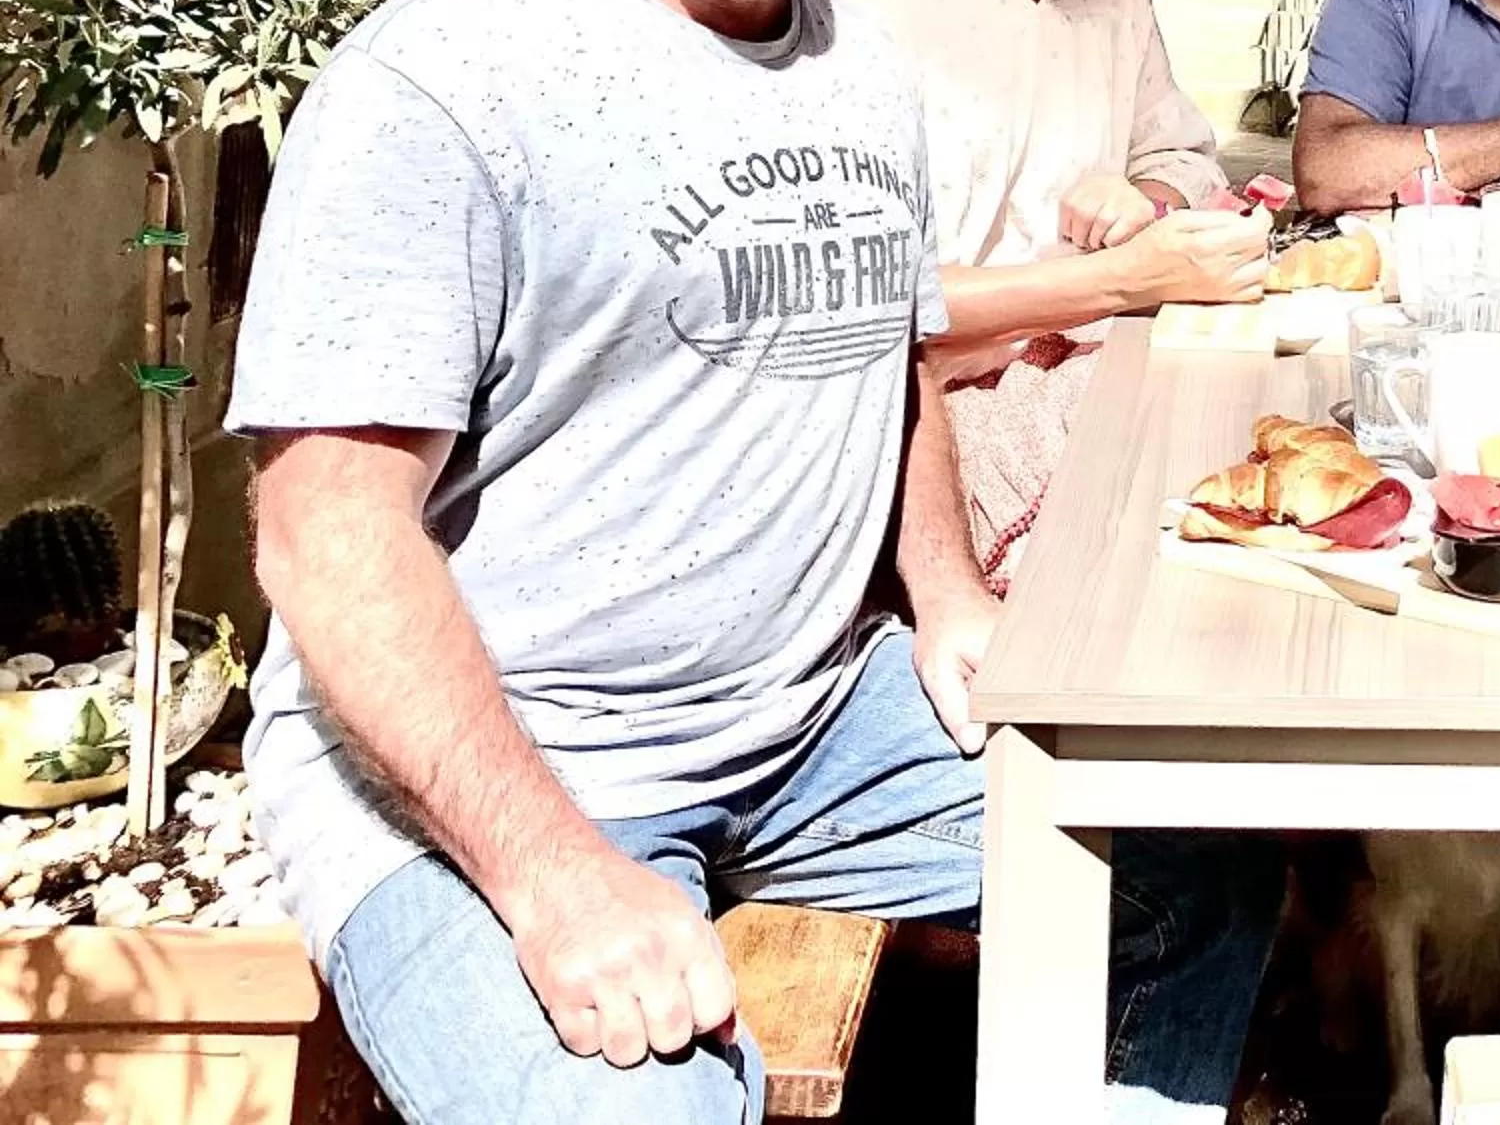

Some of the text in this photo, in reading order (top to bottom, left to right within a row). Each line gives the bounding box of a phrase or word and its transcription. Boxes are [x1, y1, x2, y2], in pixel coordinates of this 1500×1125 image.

[650, 146, 919, 265] ALL GOOD THING
[803, 202, 841, 231] ARE
[717, 230, 911, 324] WILD & FREE
